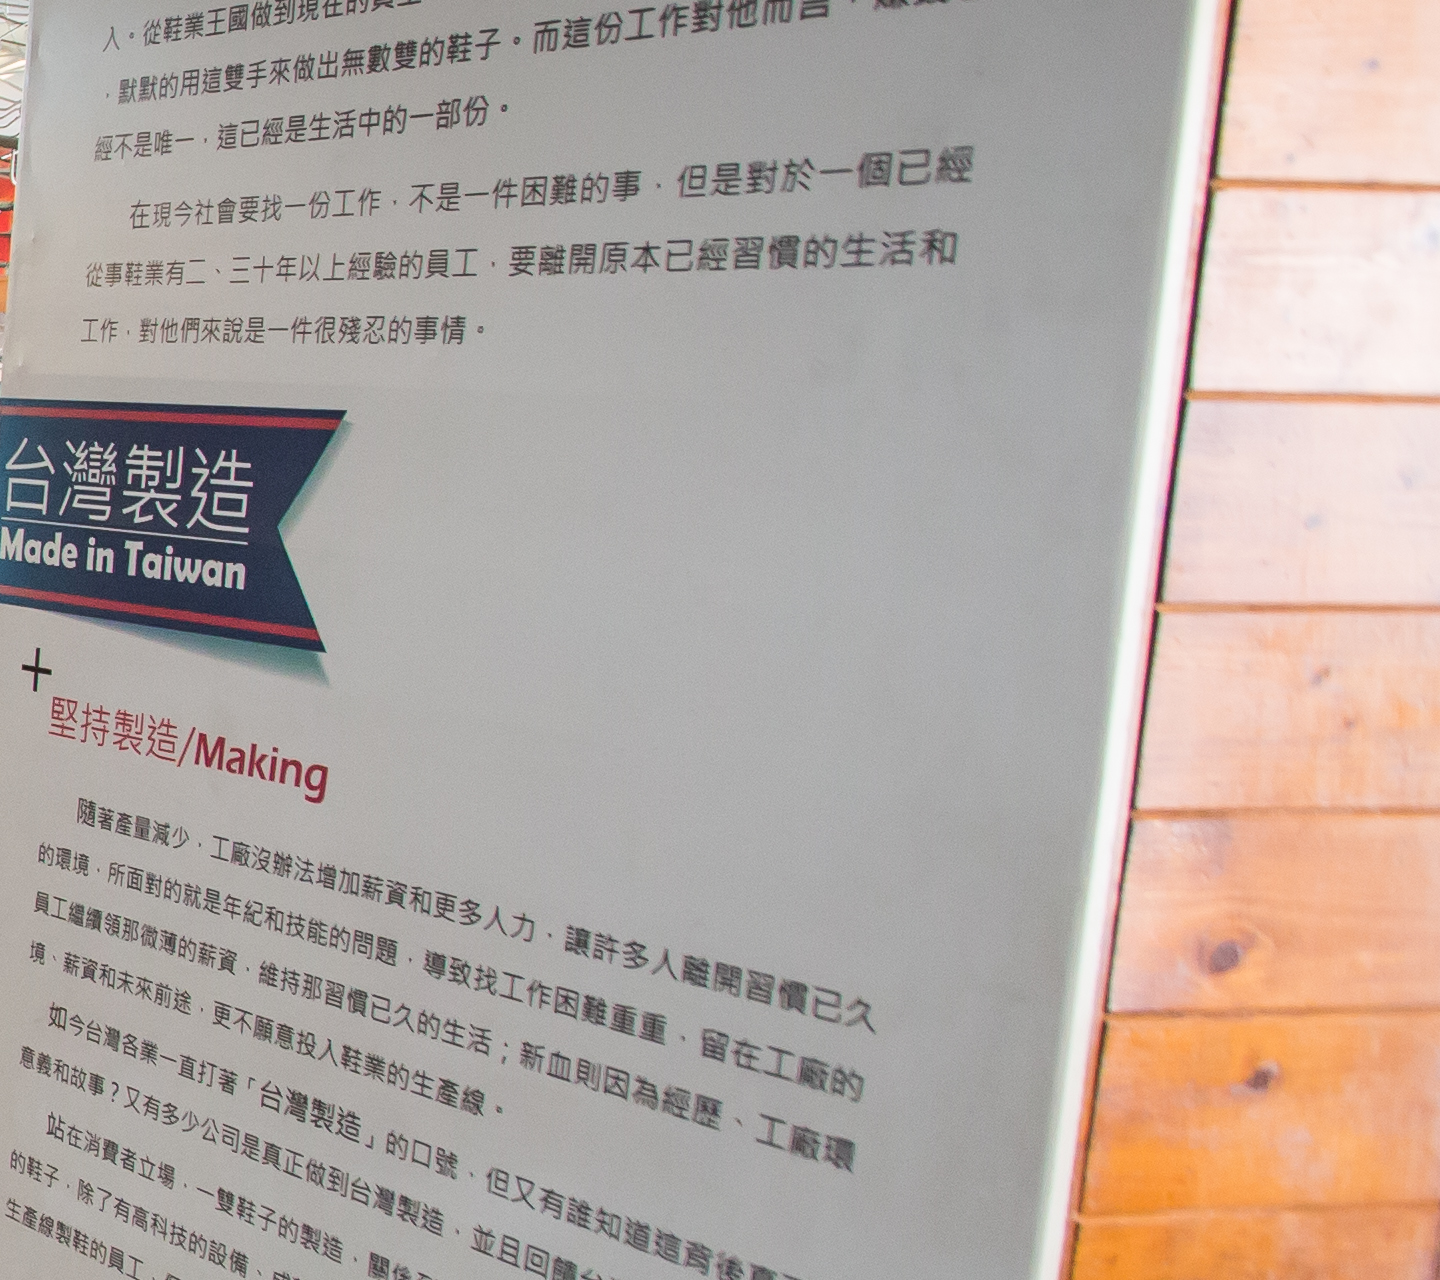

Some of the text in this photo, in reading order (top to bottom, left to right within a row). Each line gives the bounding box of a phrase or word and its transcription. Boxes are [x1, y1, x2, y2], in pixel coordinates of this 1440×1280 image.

[5, 437, 253, 534] 台灣製造
[0, 526, 247, 591] Made in Taiwan
